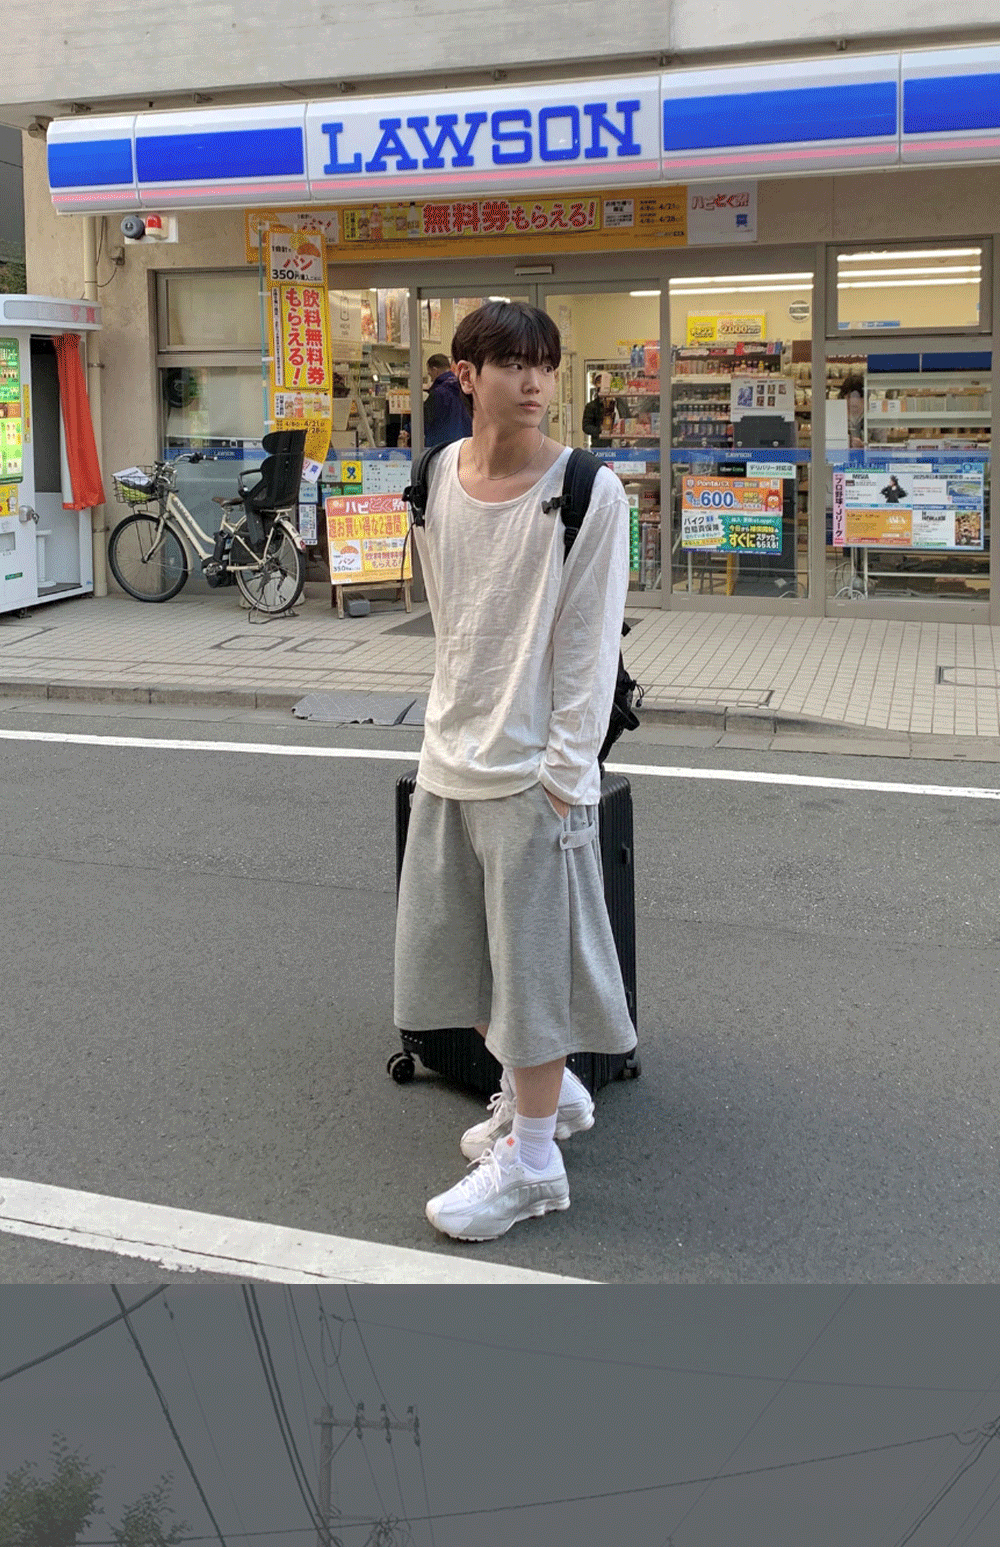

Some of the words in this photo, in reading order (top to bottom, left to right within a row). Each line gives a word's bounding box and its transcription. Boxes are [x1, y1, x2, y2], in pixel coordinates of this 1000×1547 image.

[321, 99, 641, 174] LAWSON
[423, 201, 595, 233] 無料券もらえる!
[302, 289, 325, 385] 飲料無料券
[701, 491, 734, 507] 600
